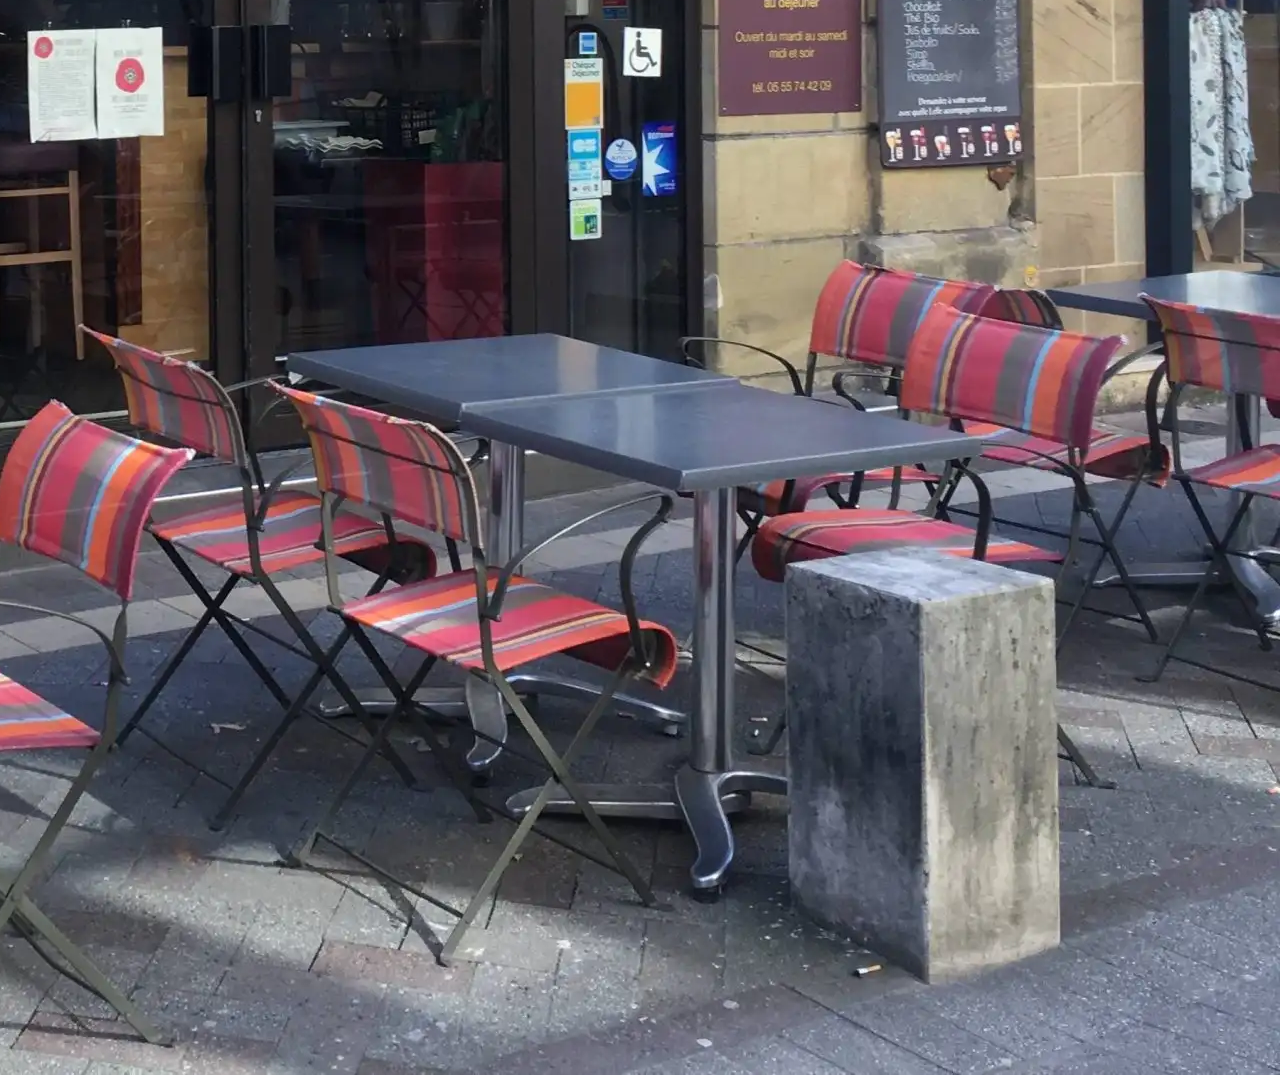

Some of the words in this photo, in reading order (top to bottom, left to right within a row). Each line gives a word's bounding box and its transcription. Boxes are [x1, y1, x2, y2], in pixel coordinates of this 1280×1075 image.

[735, 31, 764, 42] Ouvert
[766, 32, 777, 42] du
[780, 31, 803, 42] mardi
[805, 32, 816, 42] au
[817, 30, 848, 42] samedi
[769, 48, 787, 58] midi
[788, 49, 798, 58] et
[799, 47, 816, 58] soir
[780, 81, 793, 92] 55
[794, 81, 805, 92] 74
